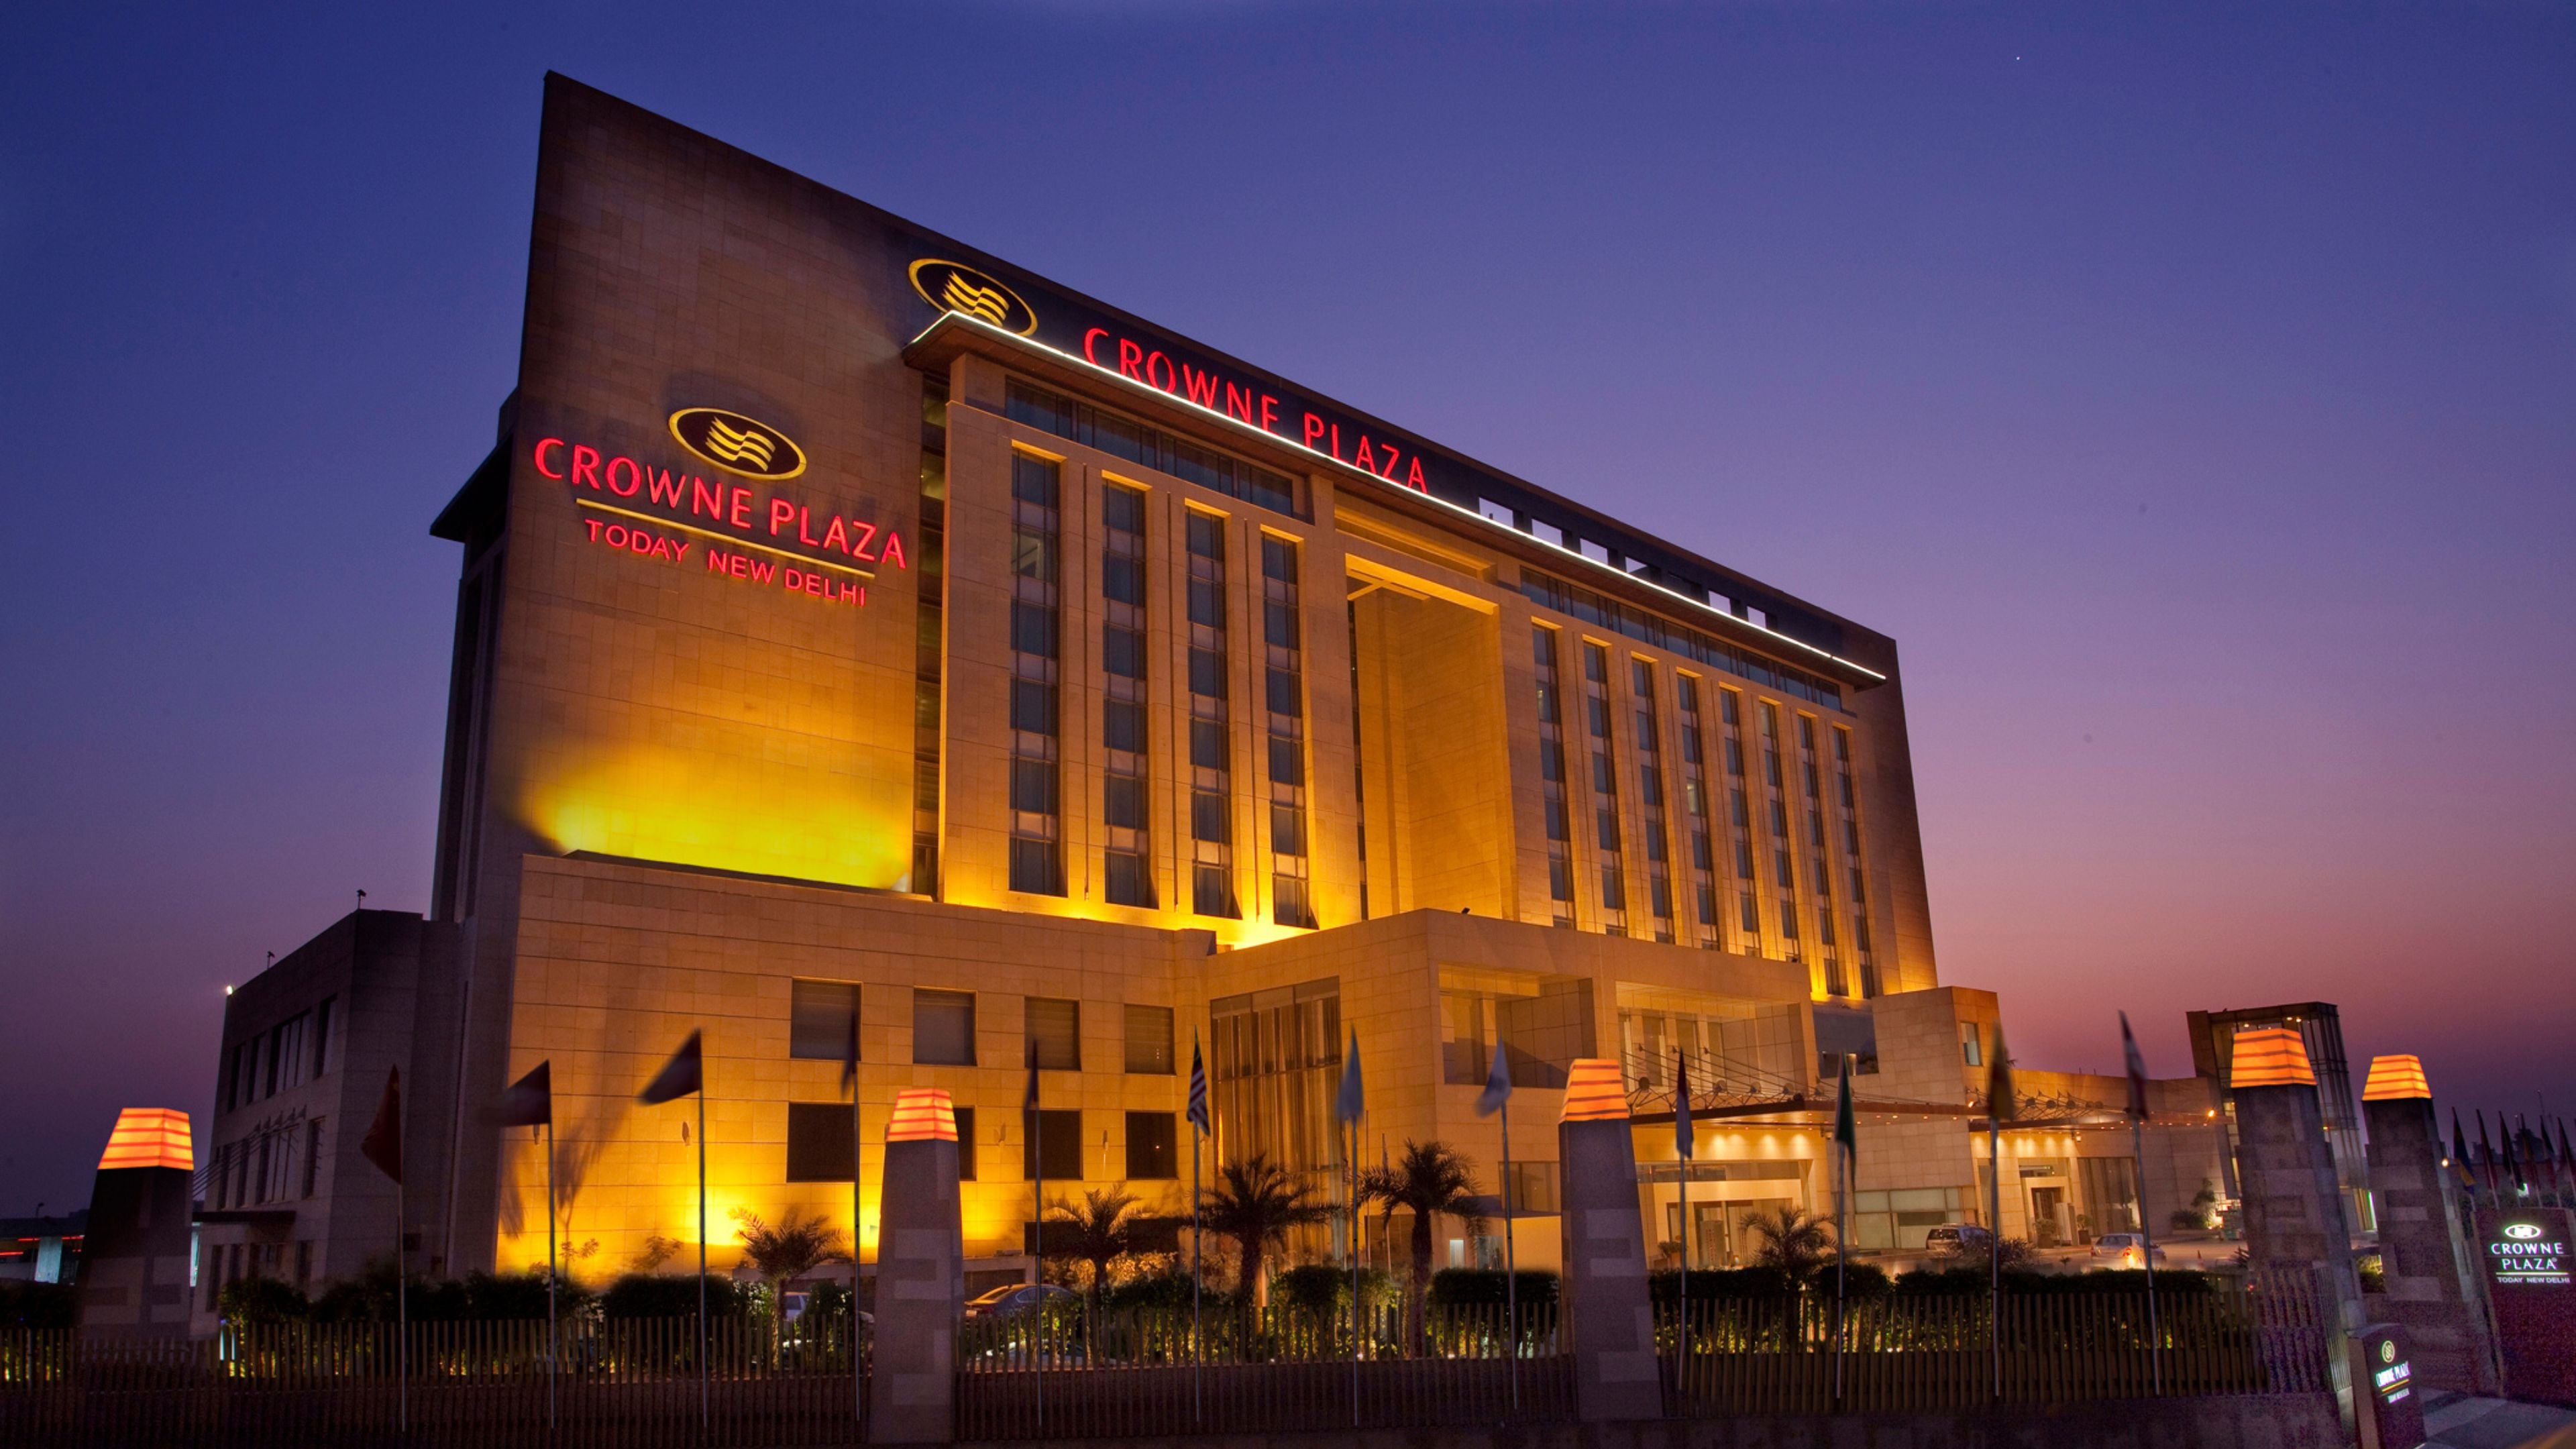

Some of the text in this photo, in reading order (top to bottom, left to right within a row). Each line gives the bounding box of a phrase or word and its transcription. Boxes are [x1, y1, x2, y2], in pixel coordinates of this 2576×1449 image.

[1083, 327, 1428, 495] CROWNE PLAZA
[534, 437, 906, 569] CROWNE PLAZA
[584, 519, 866, 607] TODAY NEW DELHI
[2491, 1242, 2564, 1254] CROWNE
